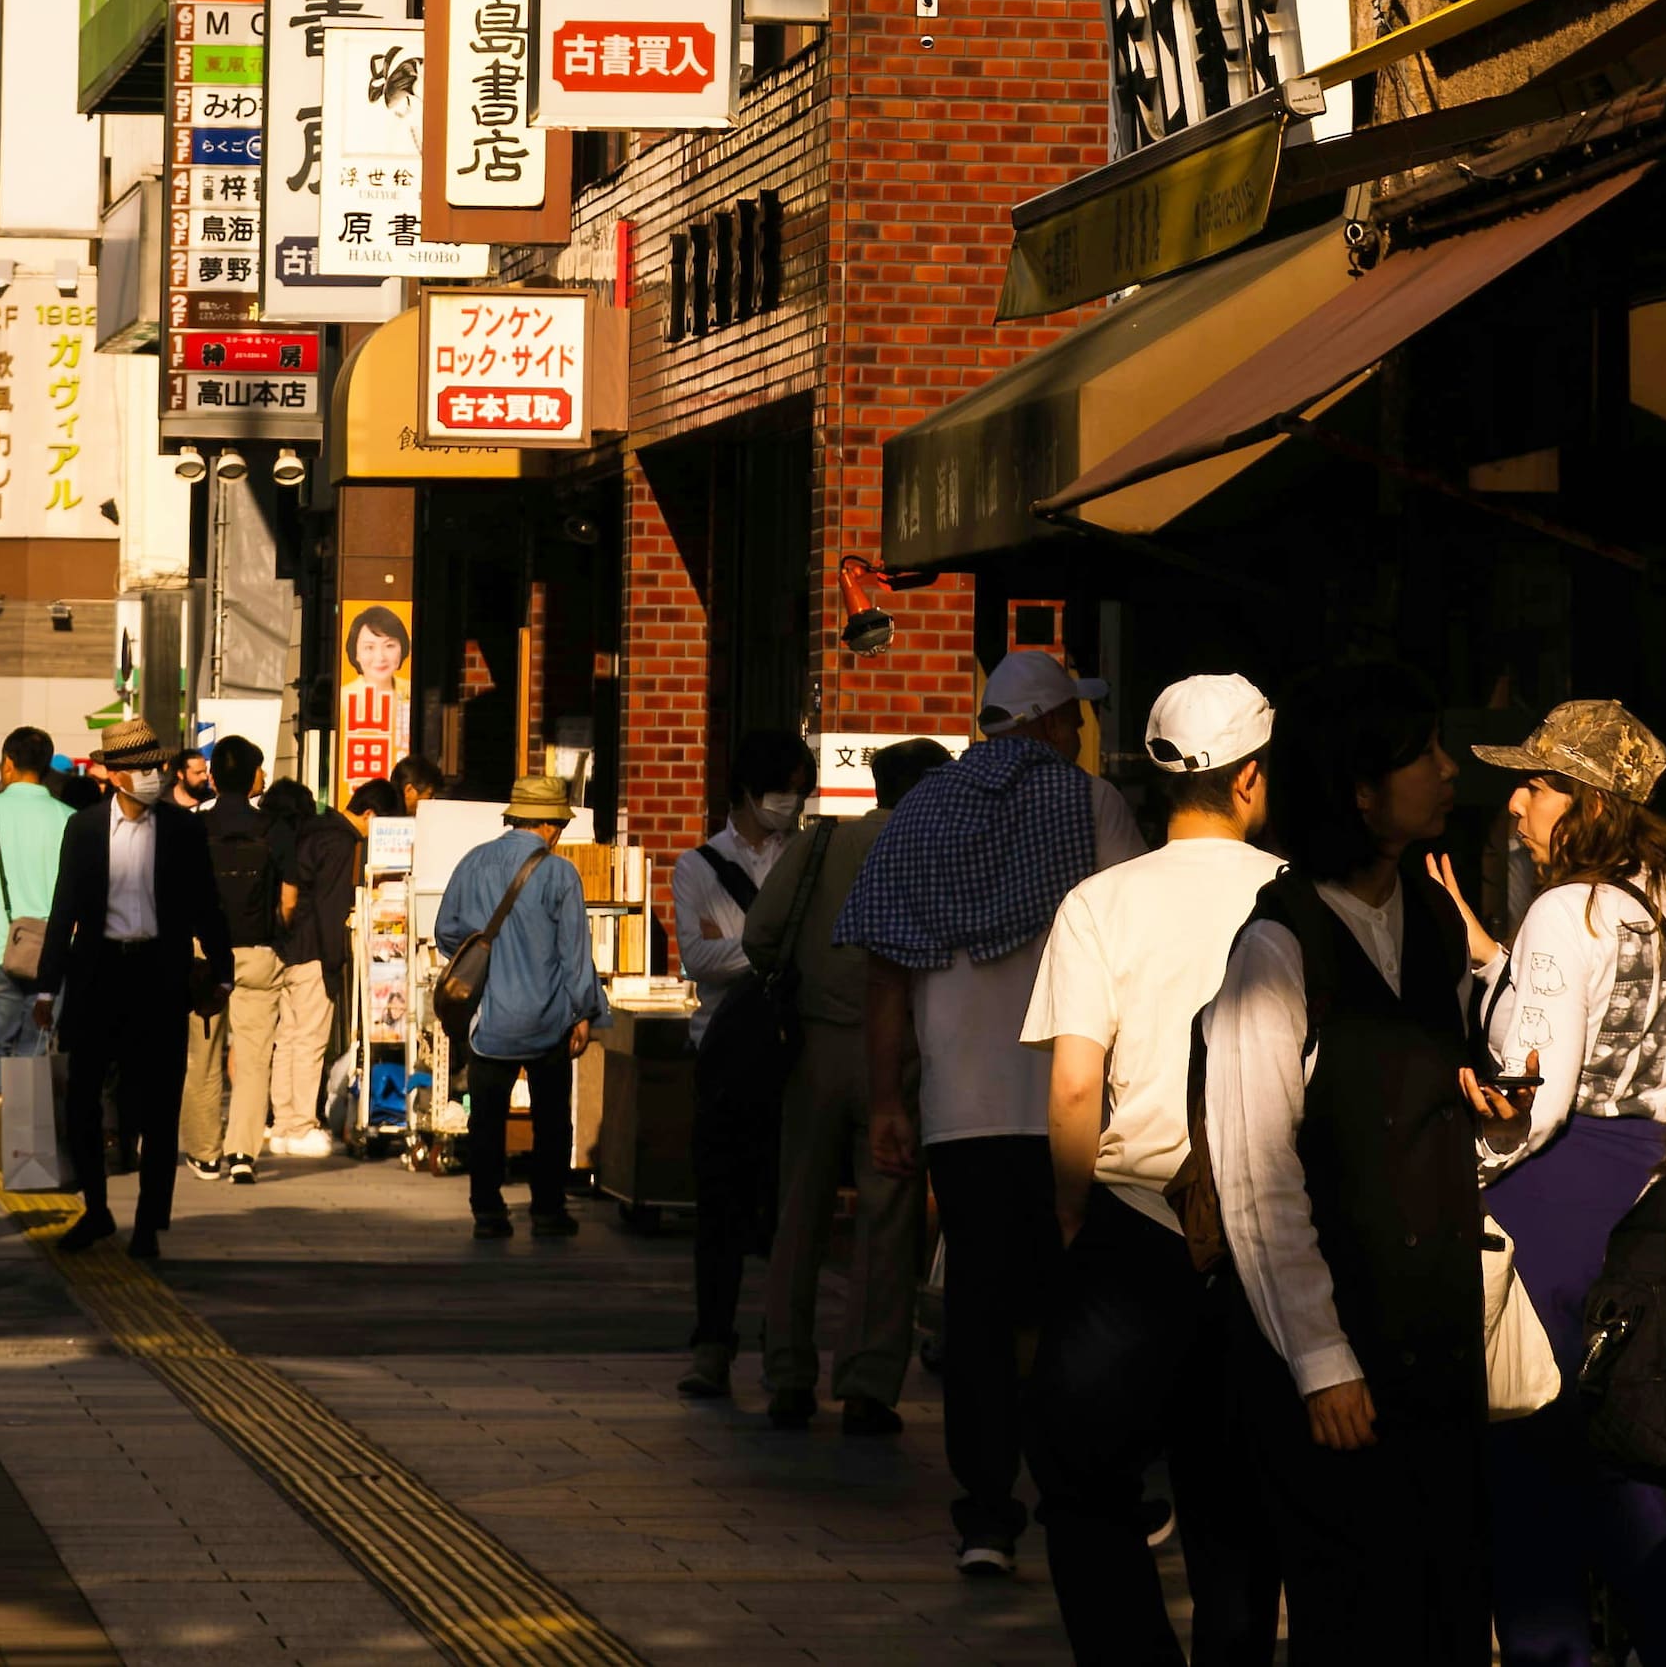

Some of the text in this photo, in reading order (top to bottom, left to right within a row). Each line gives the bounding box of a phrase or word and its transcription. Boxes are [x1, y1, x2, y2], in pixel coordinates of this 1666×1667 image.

[178, 6, 193, 38] 6F
[178, 48, 192, 80] 5F
[563, 33, 709, 77] 古書買入
[176, 90, 191, 121] 5F
[204, 93, 262, 118] みわ
[176, 130, 190, 161] 5F
[173, 172, 189, 203] 4F
[173, 212, 188, 244] 3F
[201, 215, 260, 242] 鳥海
[338, 212, 461, 247] 原書
[171, 251, 187, 284] 2F
[199, 256, 259, 282] 夢野
[349, 249, 460, 264] HARA SHOBO
[35, 305, 96, 326] 1982
[171, 295, 187, 326] 2F
[461, 304, 553, 338] ブンケン
[437, 345, 575, 378] ロック・サイド
[197, 380, 306, 409] 高山本店
[449, 394, 561, 423] 古本買取
[45, 334, 83, 511] ガヴィアル
[346, 686, 391, 792] 山田
